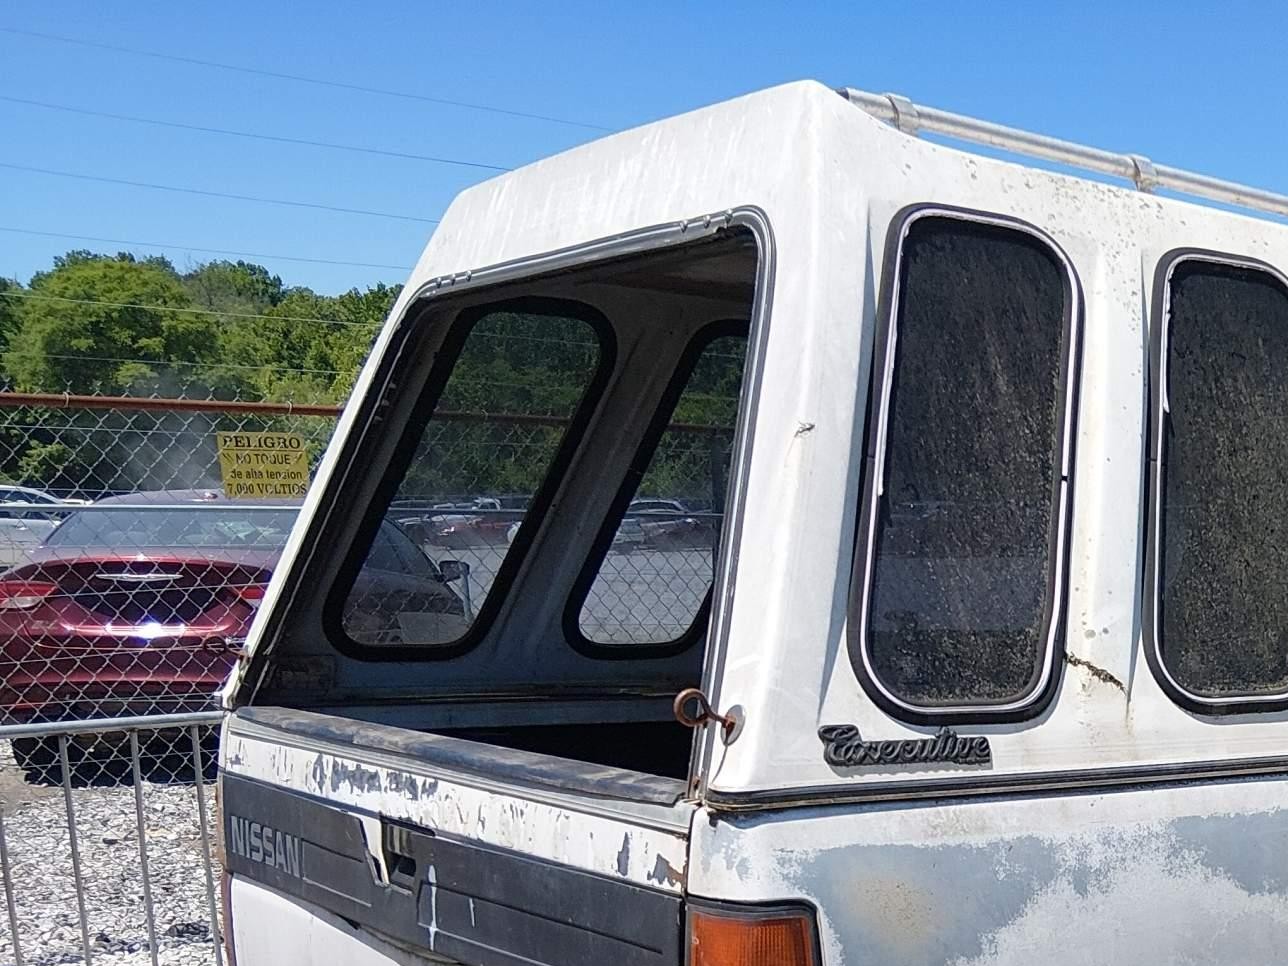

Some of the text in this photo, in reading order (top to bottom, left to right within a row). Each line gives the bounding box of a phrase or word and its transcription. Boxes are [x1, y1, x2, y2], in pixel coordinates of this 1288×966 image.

[222, 435, 301, 449] PELIGRO
[235, 453, 291, 465] NO TOQUE
[230, 469, 243, 479] de
[245, 469, 264, 480] alta
[227, 483, 255, 496] 7,000
[818, 724, 993, 767] Executive
[230, 815, 301, 879] NISSAN
